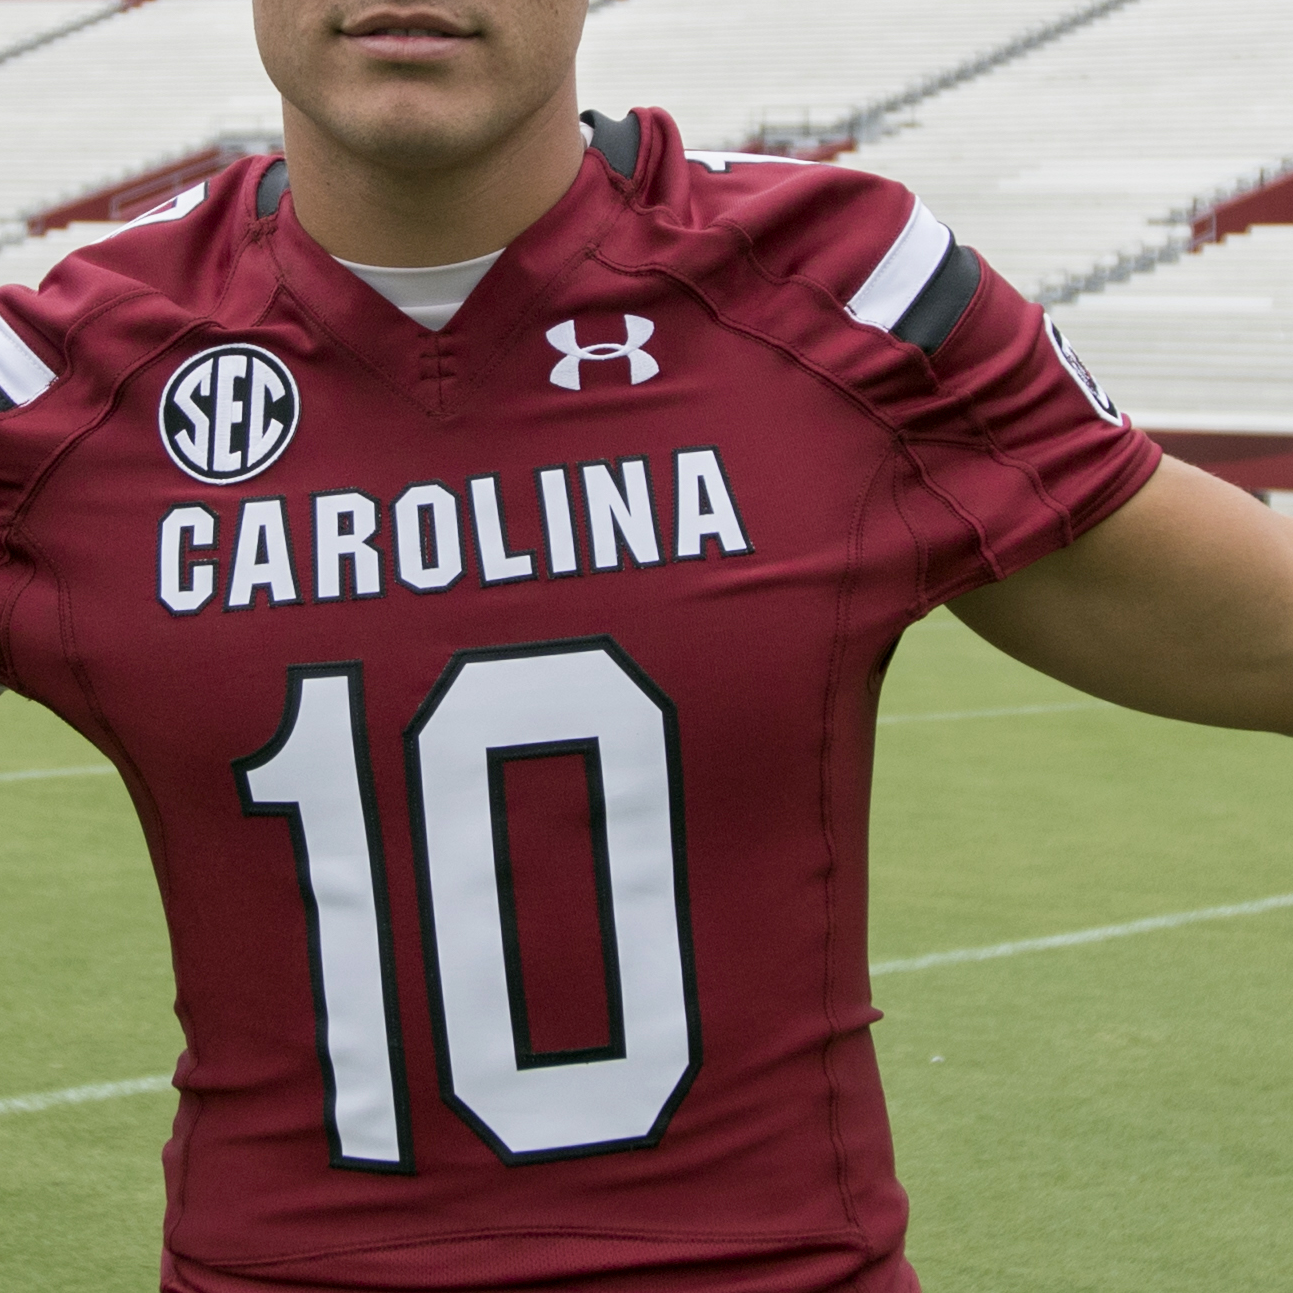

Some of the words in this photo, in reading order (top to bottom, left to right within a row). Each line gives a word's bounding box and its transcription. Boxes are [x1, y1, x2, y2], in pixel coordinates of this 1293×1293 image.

[173, 354, 287, 472] SEC
[158, 446, 754, 615] CAROLINA
[231, 633, 703, 1175] 10
